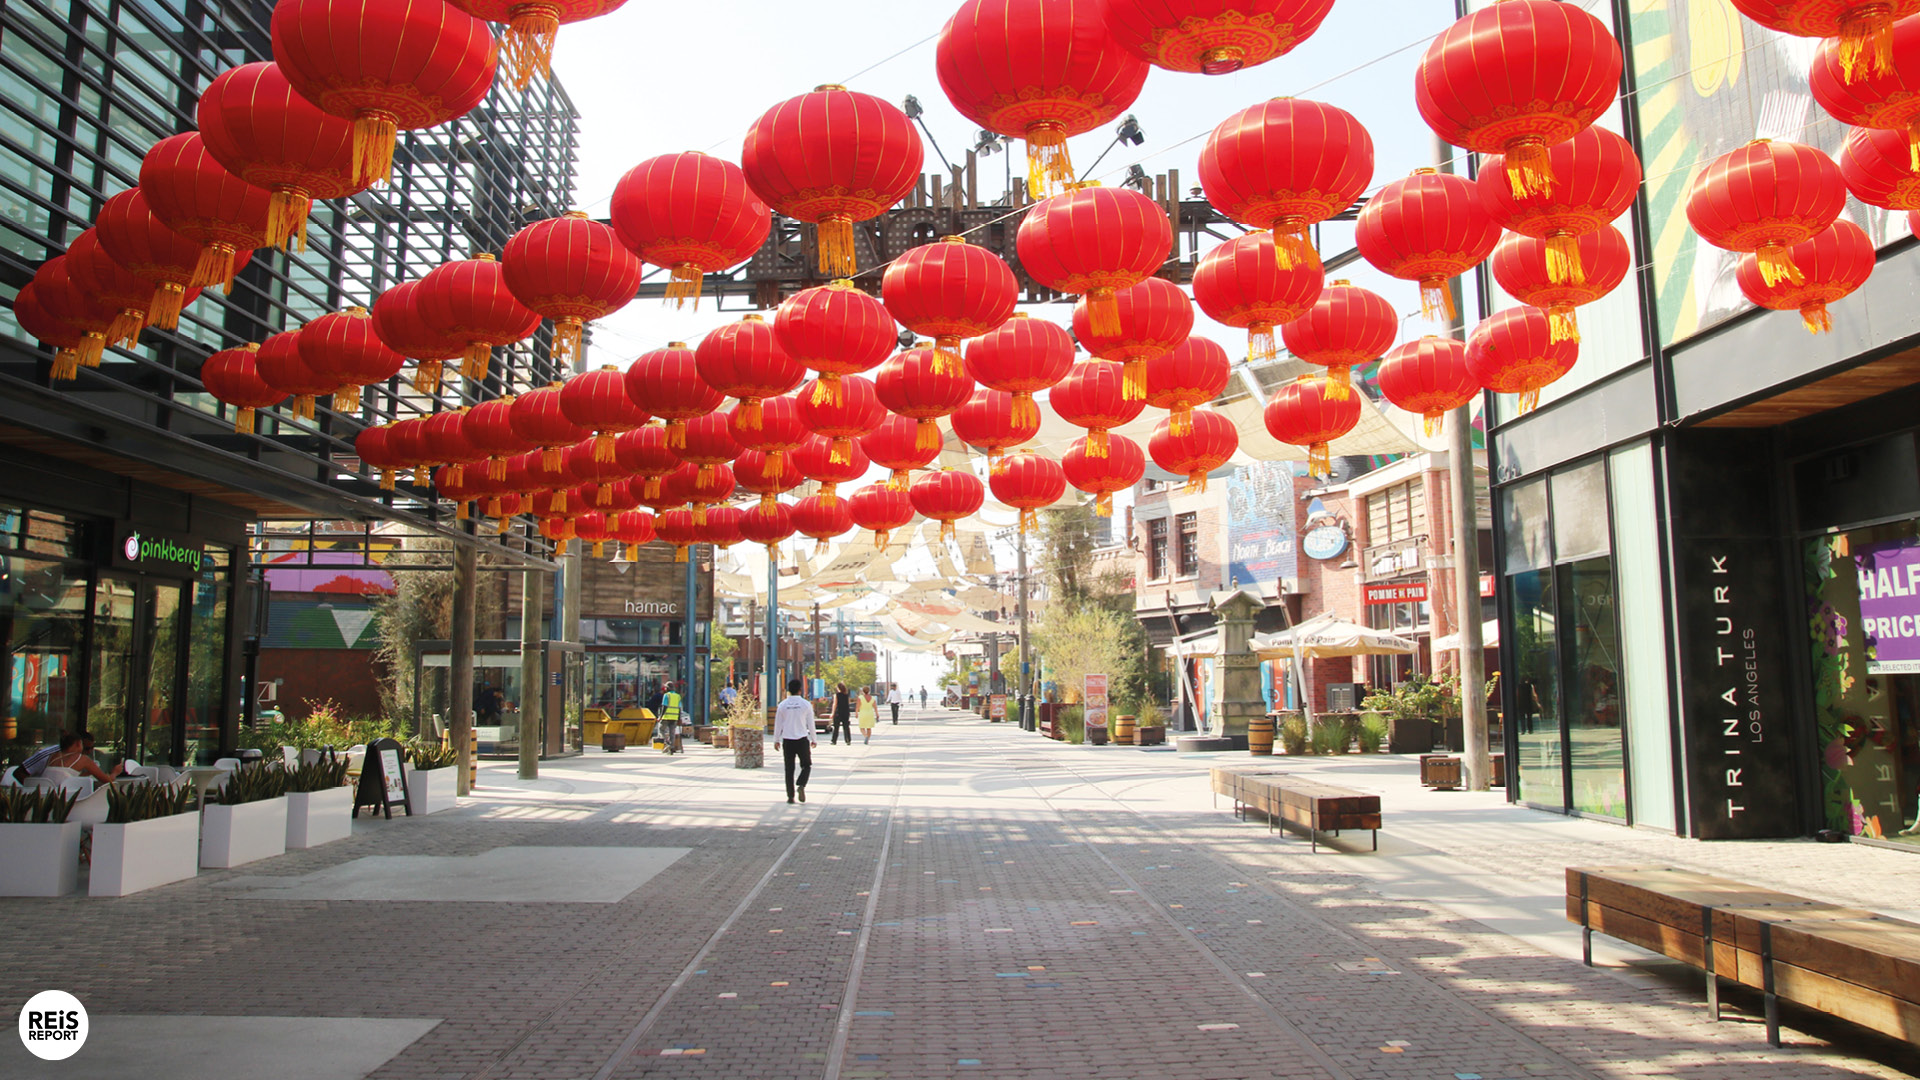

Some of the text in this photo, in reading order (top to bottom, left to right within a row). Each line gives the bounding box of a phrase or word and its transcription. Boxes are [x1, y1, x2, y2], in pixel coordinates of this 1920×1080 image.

[141, 537, 201, 572] pinkberry
[1368, 588, 1398, 600] POMME
[1406, 586, 1425, 598] PAIN
[1858, 562, 1920, 600] HALF
[625, 599, 677, 614] hamac
[1711, 555, 1745, 818] TRINA TURK
[1743, 627, 1763, 742] LOS ANGELES
